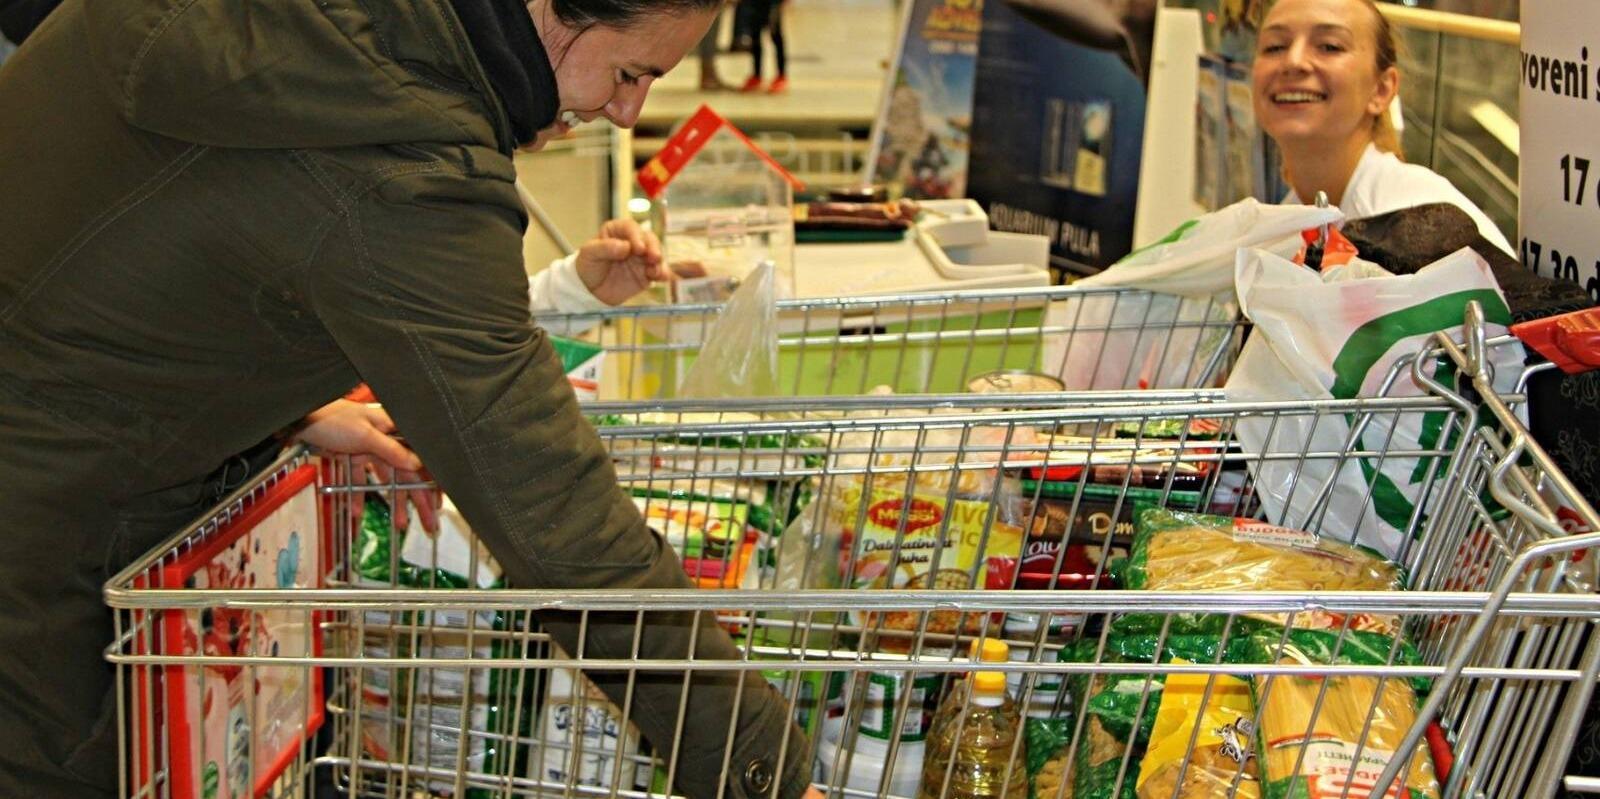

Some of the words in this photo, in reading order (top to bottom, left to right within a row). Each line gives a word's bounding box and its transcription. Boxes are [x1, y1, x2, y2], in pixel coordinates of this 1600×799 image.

[1560, 153, 1590, 206] 17
[1061, 221, 1100, 259] PULA
[1317, 751, 1388, 767] SPAHETTI
